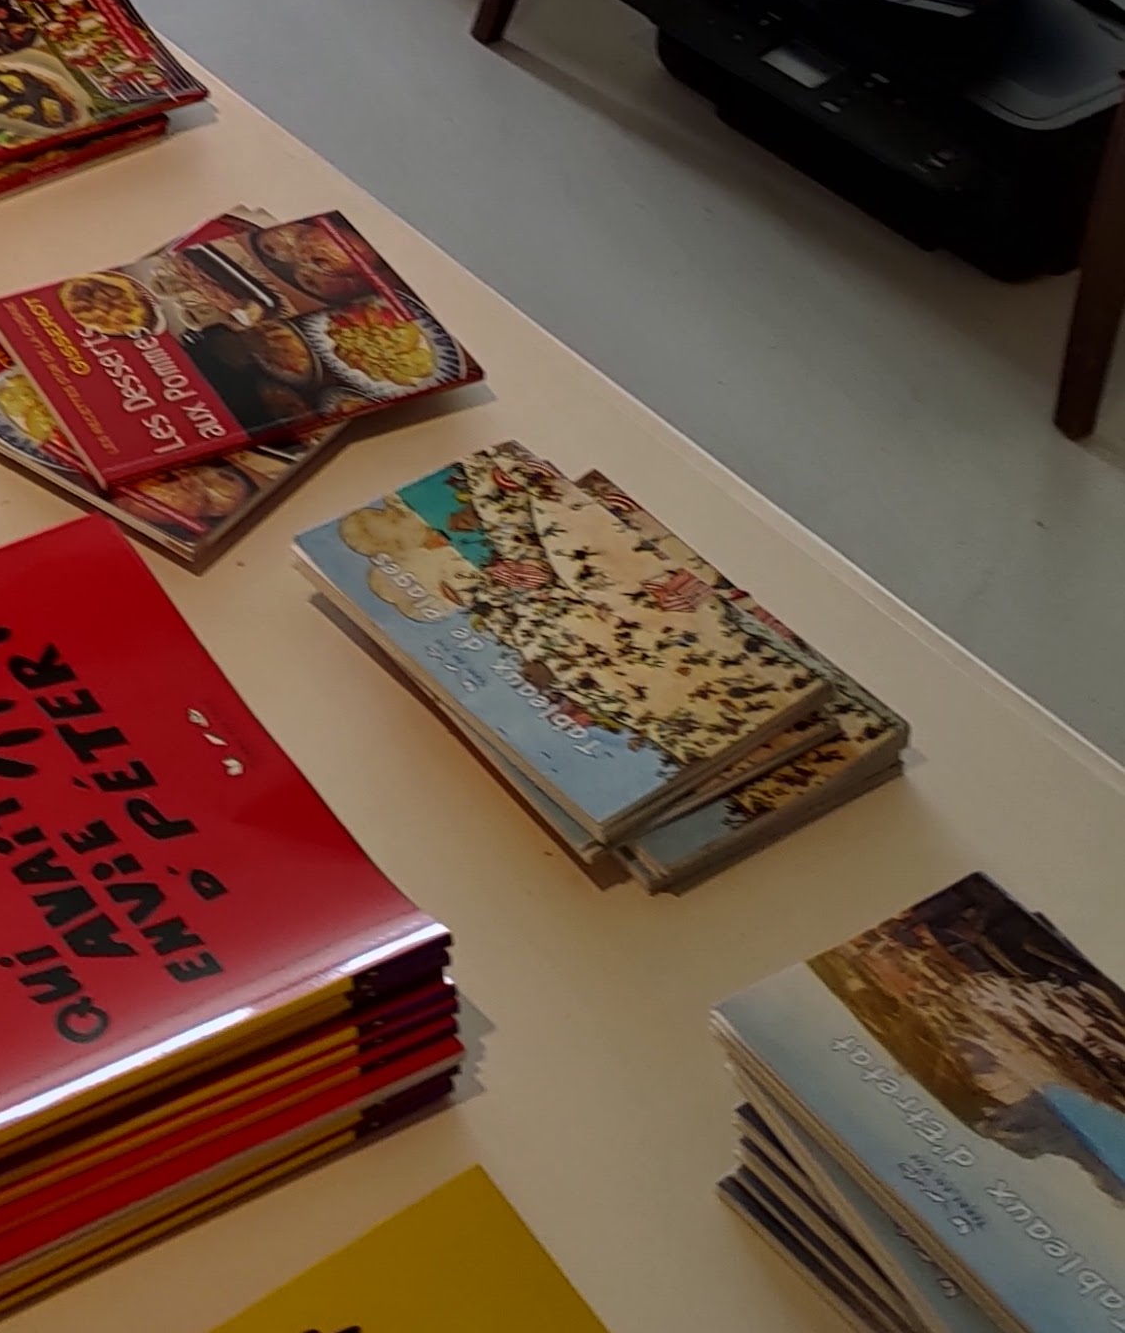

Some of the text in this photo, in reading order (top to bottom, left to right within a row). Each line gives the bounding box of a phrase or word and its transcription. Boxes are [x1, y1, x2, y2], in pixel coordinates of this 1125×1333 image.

[76, 326, 188, 455] Les Desserts
[129, 325, 228, 442] aux Pommes
[369, 552, 446, 623] Plages
[450, 625, 487, 653] de
[490, 661, 604, 760] Tableaux
